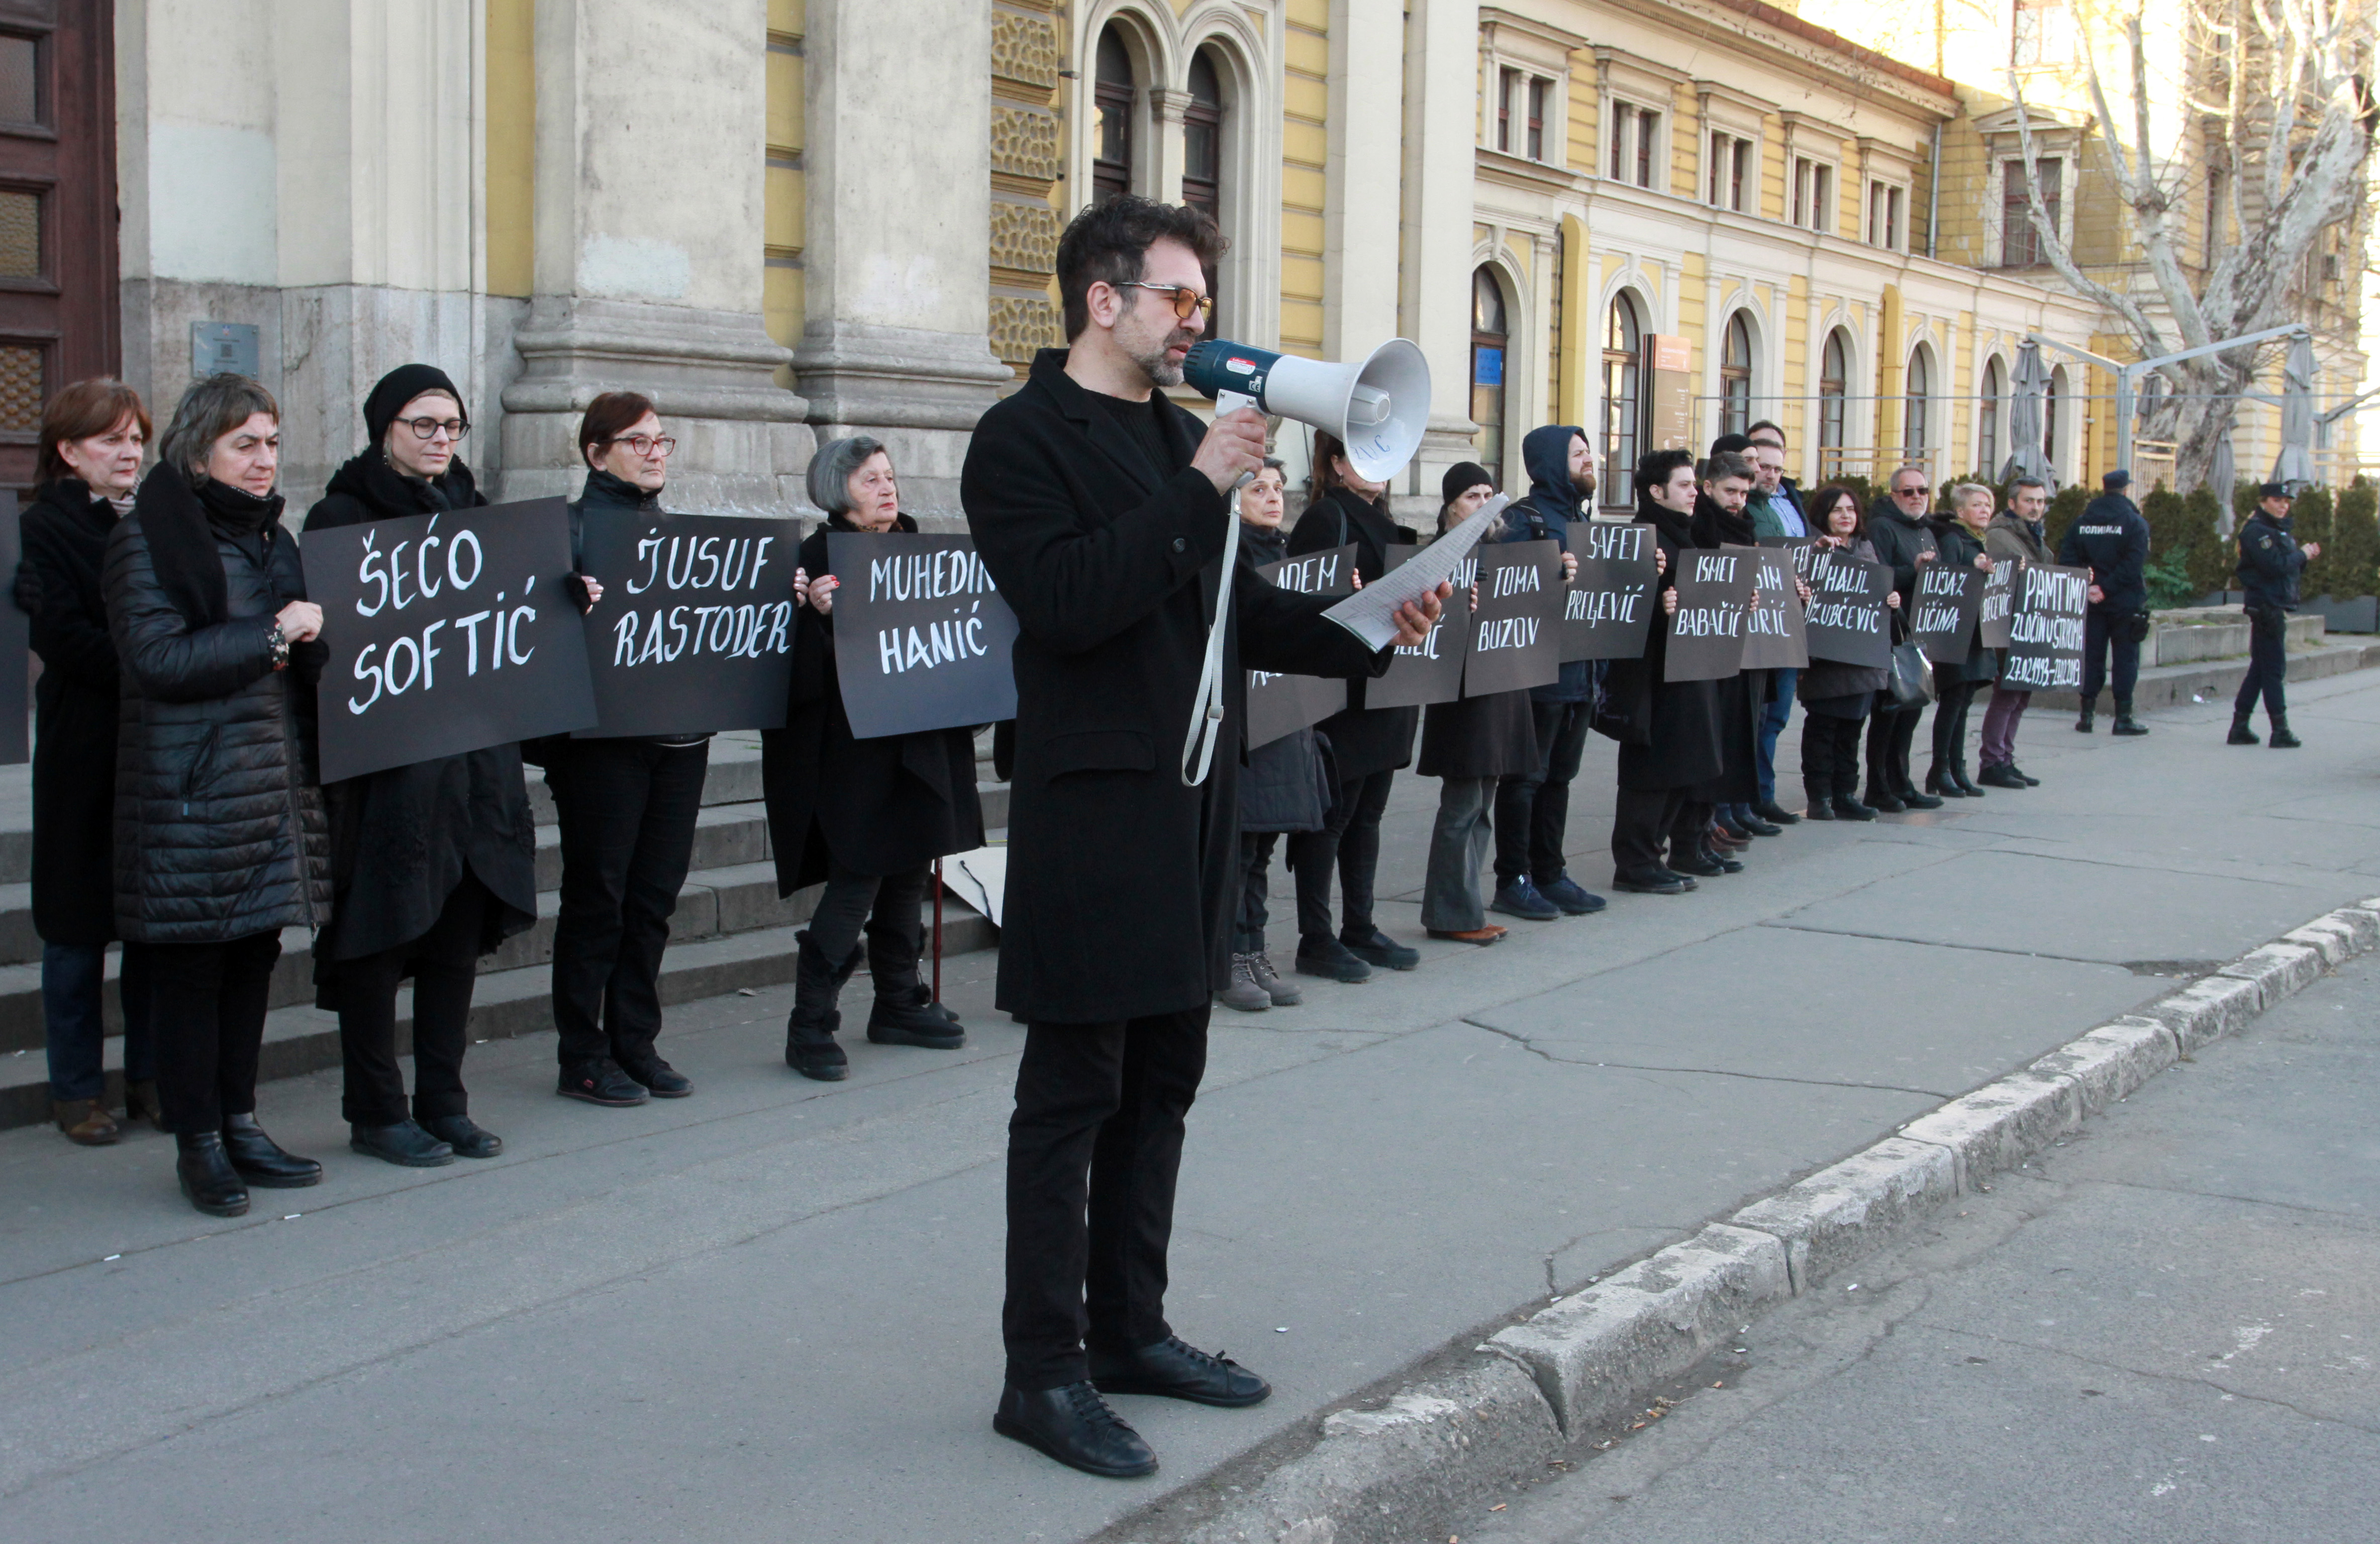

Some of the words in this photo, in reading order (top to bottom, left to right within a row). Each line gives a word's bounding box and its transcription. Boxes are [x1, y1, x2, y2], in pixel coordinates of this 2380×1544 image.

[627, 527, 774, 594] JUSUF
[1587, 526, 1646, 561] SAFET
[356, 513, 482, 617] ŠEĆO
[1277, 554, 1338, 593] ADEM
[1494, 565, 1540, 598] TOMA
[1696, 555, 1737, 583] ISMET
[1824, 564, 1869, 594] HALIL
[2023, 567, 2086, 615] PAMTIMO
[613, 600, 791, 667] RASTODER
[1674, 601, 1743, 637] BABAČIĆ
[1916, 599, 1960, 633] LIČINA
[2046, 619, 2054, 643] U
[348, 575, 536, 715] SOFTIĆ
[879, 600, 988, 674] HANIĆ
[1477, 617, 1540, 652] BUZOV
